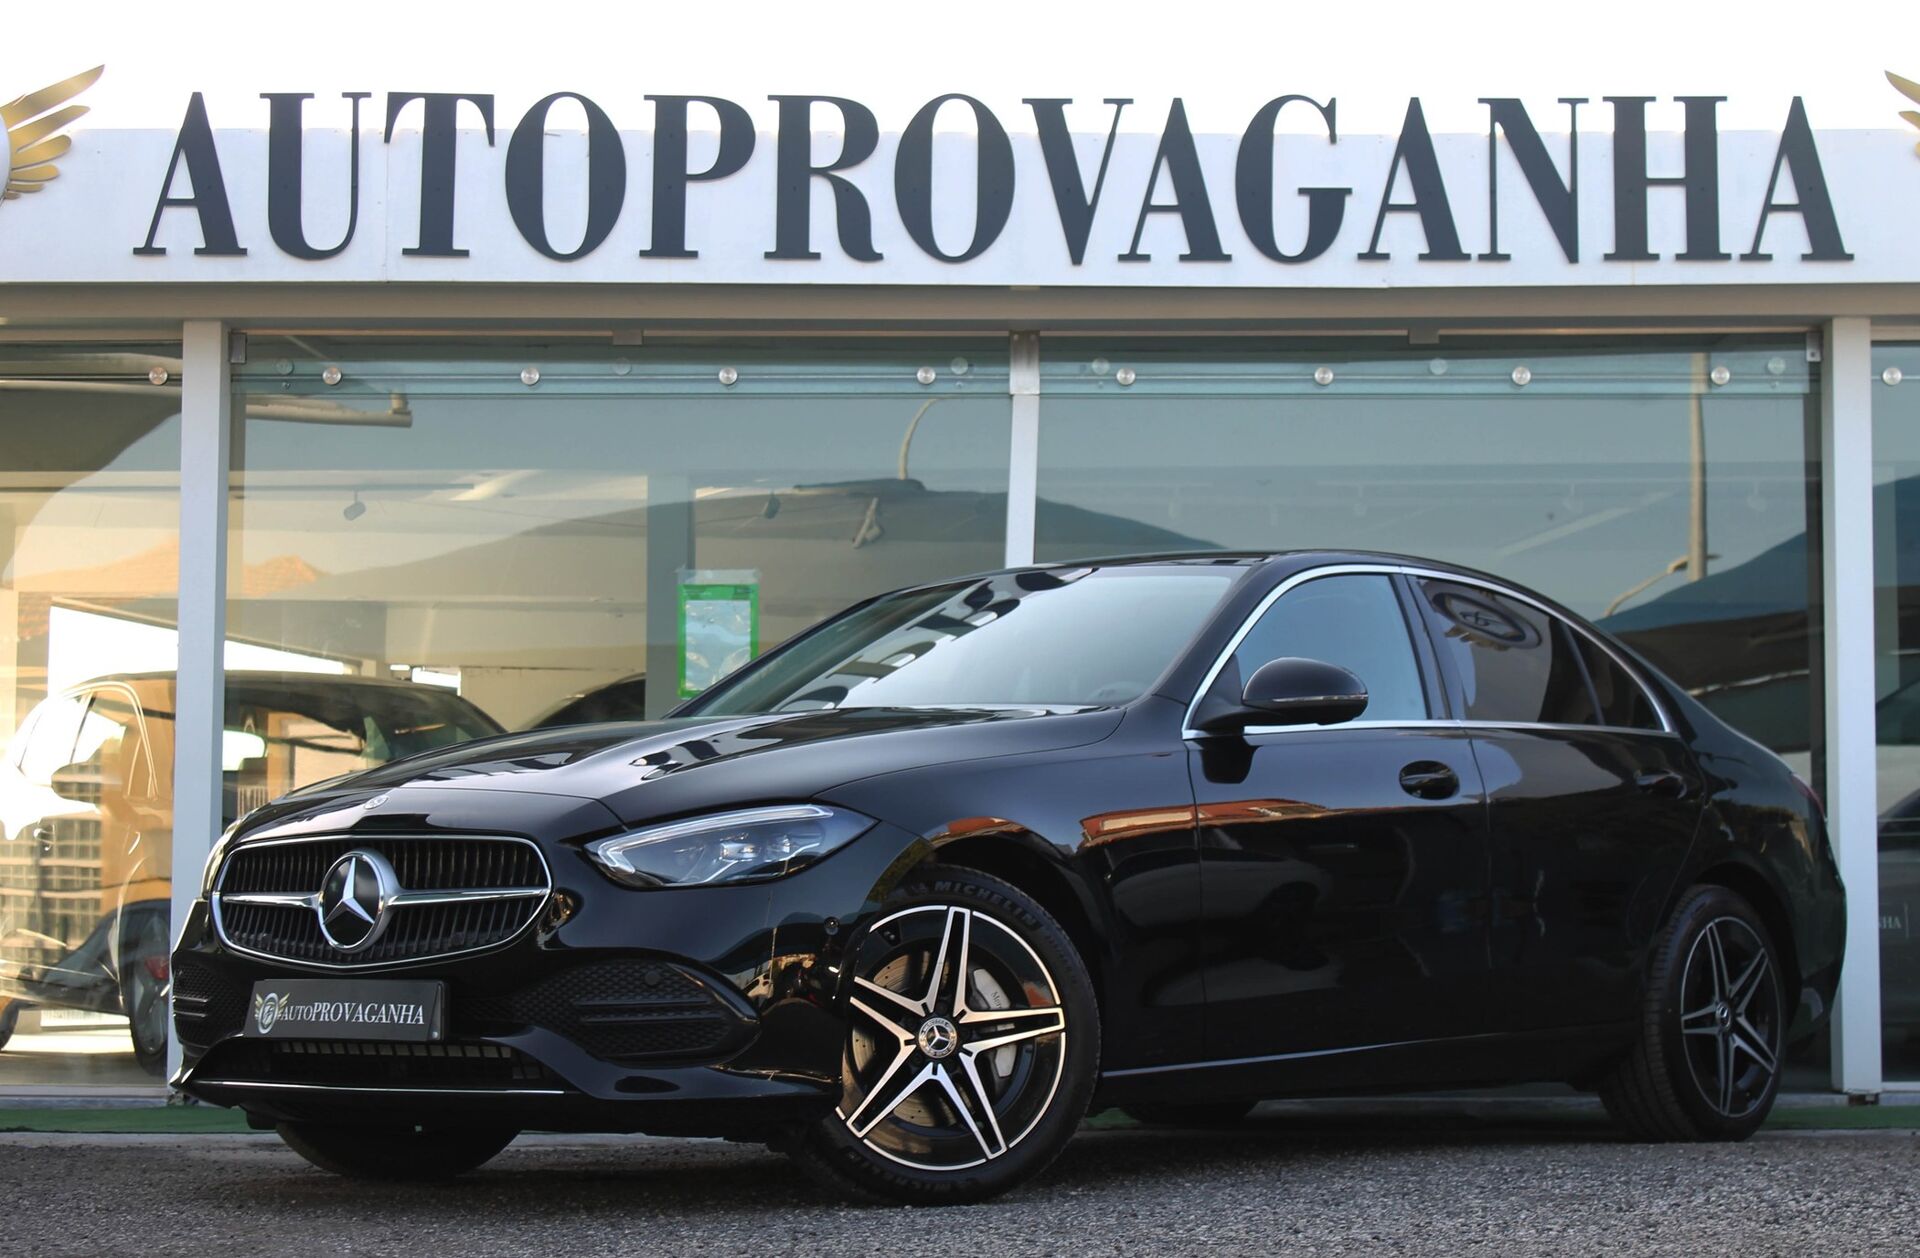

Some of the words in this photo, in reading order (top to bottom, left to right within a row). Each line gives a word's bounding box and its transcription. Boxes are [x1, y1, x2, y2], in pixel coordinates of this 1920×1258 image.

[133, 92, 1854, 265] AUTOPROVAGANHA
[934, 880, 1041, 930] MICHELIN
[280, 1002, 425, 1025] AUTOPROVAGANHA
